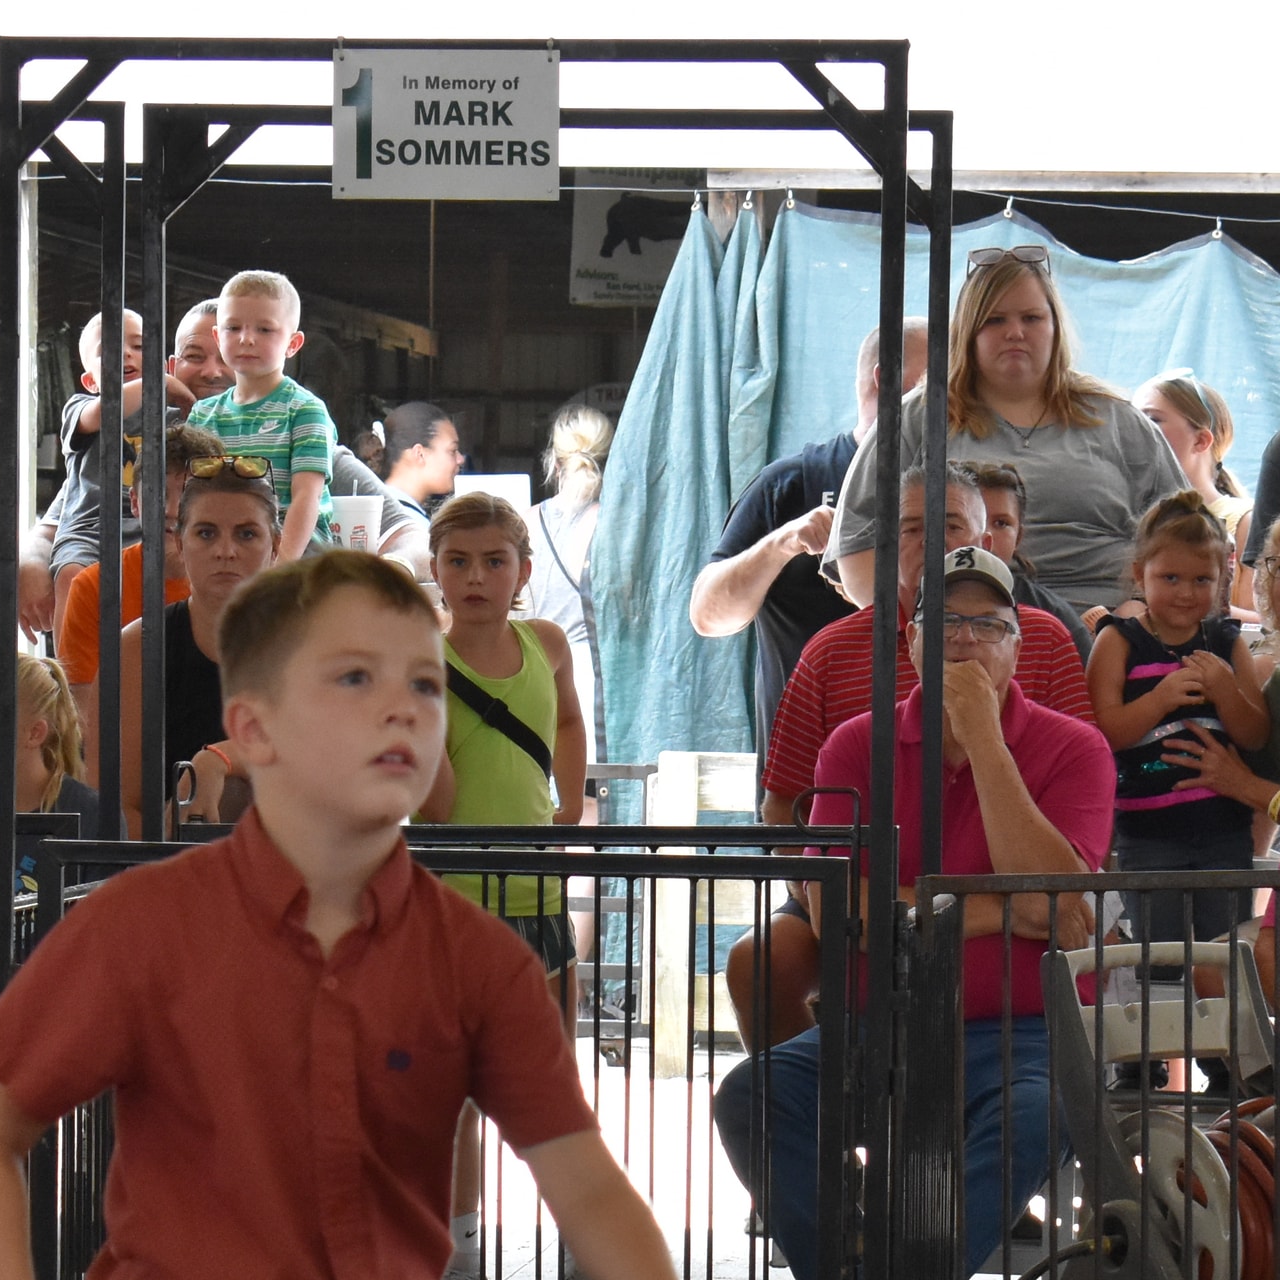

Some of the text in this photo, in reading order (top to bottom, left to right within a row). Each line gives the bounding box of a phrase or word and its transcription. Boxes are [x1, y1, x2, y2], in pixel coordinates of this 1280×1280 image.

[402, 75, 519, 93] In Memory of
[342, 68, 372, 179] 1
[414, 101, 513, 126] MARK
[376, 139, 550, 166] SOMMERS
